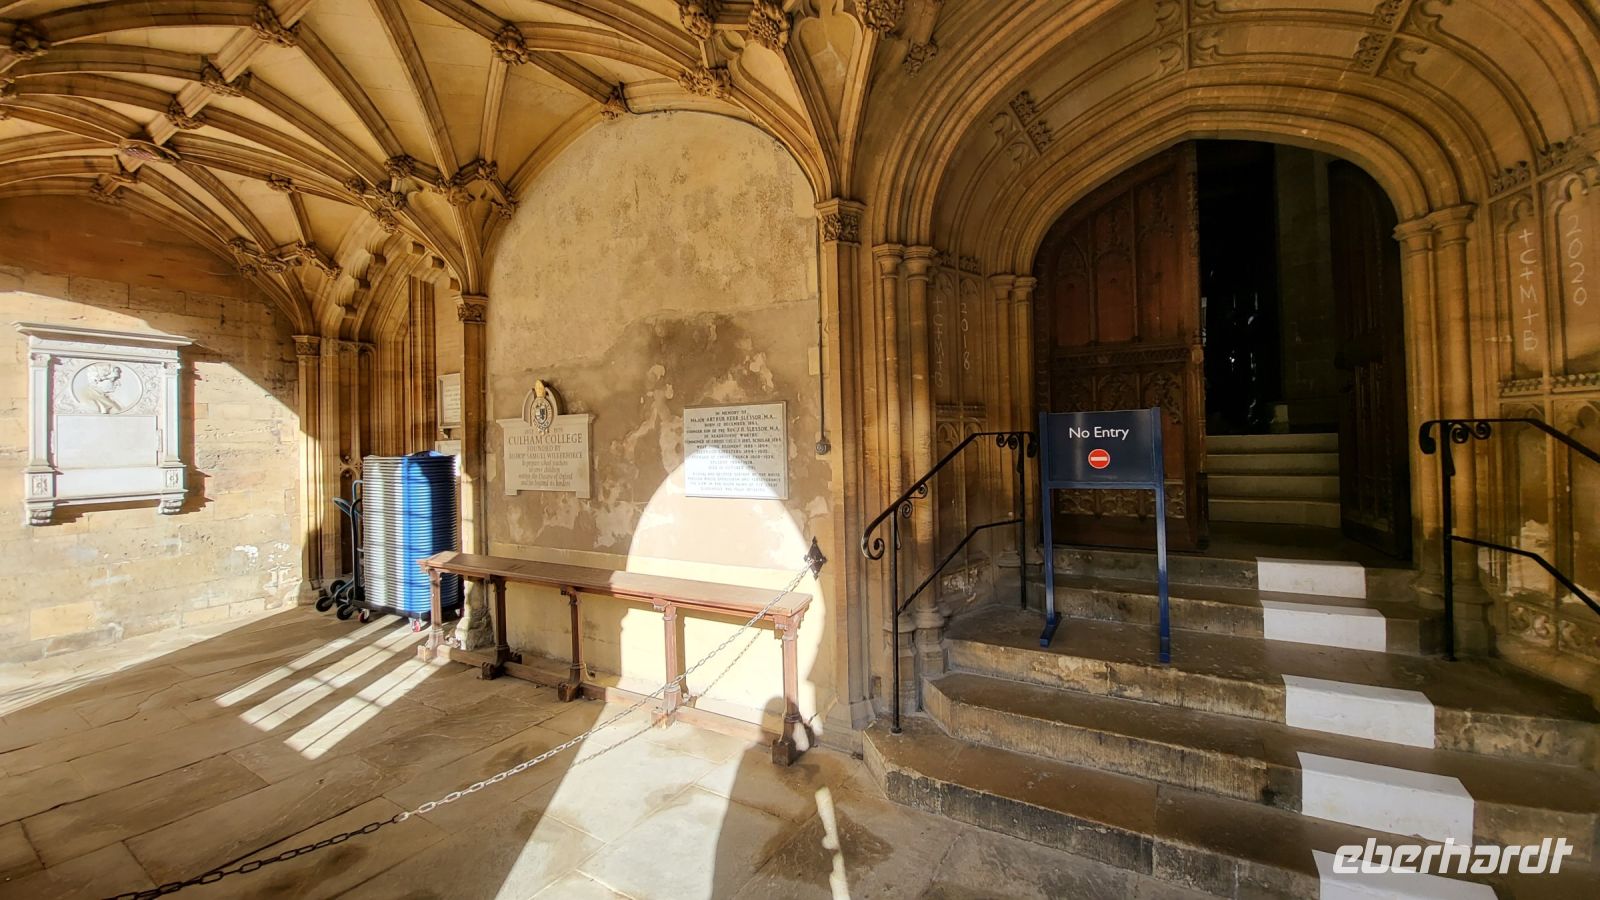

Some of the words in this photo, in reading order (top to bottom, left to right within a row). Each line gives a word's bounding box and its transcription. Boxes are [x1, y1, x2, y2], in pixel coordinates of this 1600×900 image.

[1566, 215, 1587, 306] 2020
[508, 435, 542, 446] CULHAM
[545, 432, 583, 445] COLLEGE
[1069, 427, 1090, 439] No
[1094, 426, 1130, 441] Entry
